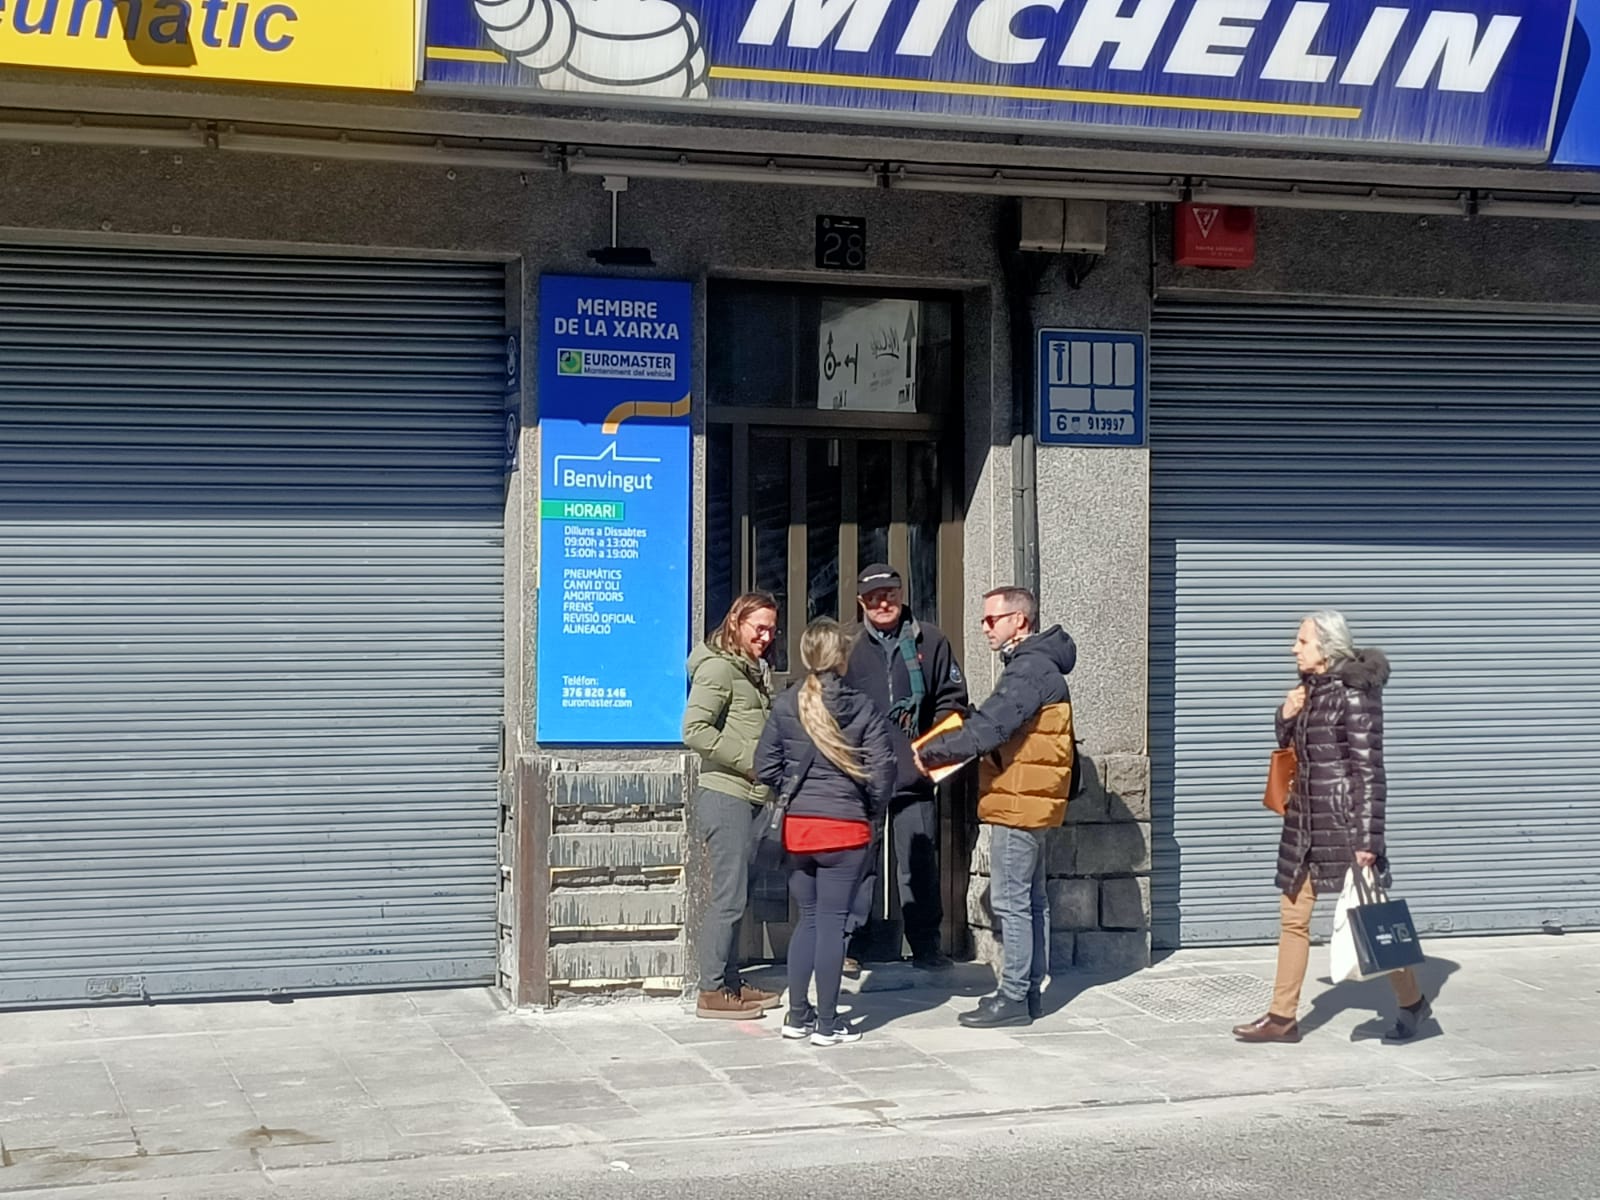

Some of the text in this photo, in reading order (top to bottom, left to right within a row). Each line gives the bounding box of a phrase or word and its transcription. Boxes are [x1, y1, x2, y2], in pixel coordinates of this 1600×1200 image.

[0, 0, 299, 52] umatic
[737, 0, 1522, 93] MICHELIN
[823, 232, 863, 266] 28
[577, 298, 657, 318] MEMBRE
[554, 317, 680, 340] DE LA XARXA
[584, 353, 672, 369] EUROMASTER
[1056, 414, 1125, 431] 6 913997
[563, 469, 653, 493] Benvingut
[564, 503, 616, 518] HORARI
[564, 525, 647, 537] Dilluns a Dissabtes
[564, 536, 639, 549] 09:00h a 13:00h
[564, 547, 639, 559] 15:00h a 19:00h
[563, 580, 593, 590] CANVI
[563, 590, 624, 602] AMORTIDORS
[563, 601, 594, 612] FRENS
[563, 612, 636, 624] REVISIÓ OFICIAL
[562, 687, 627, 698] 376 820 146
[562, 699, 633, 708] euromaster.com
